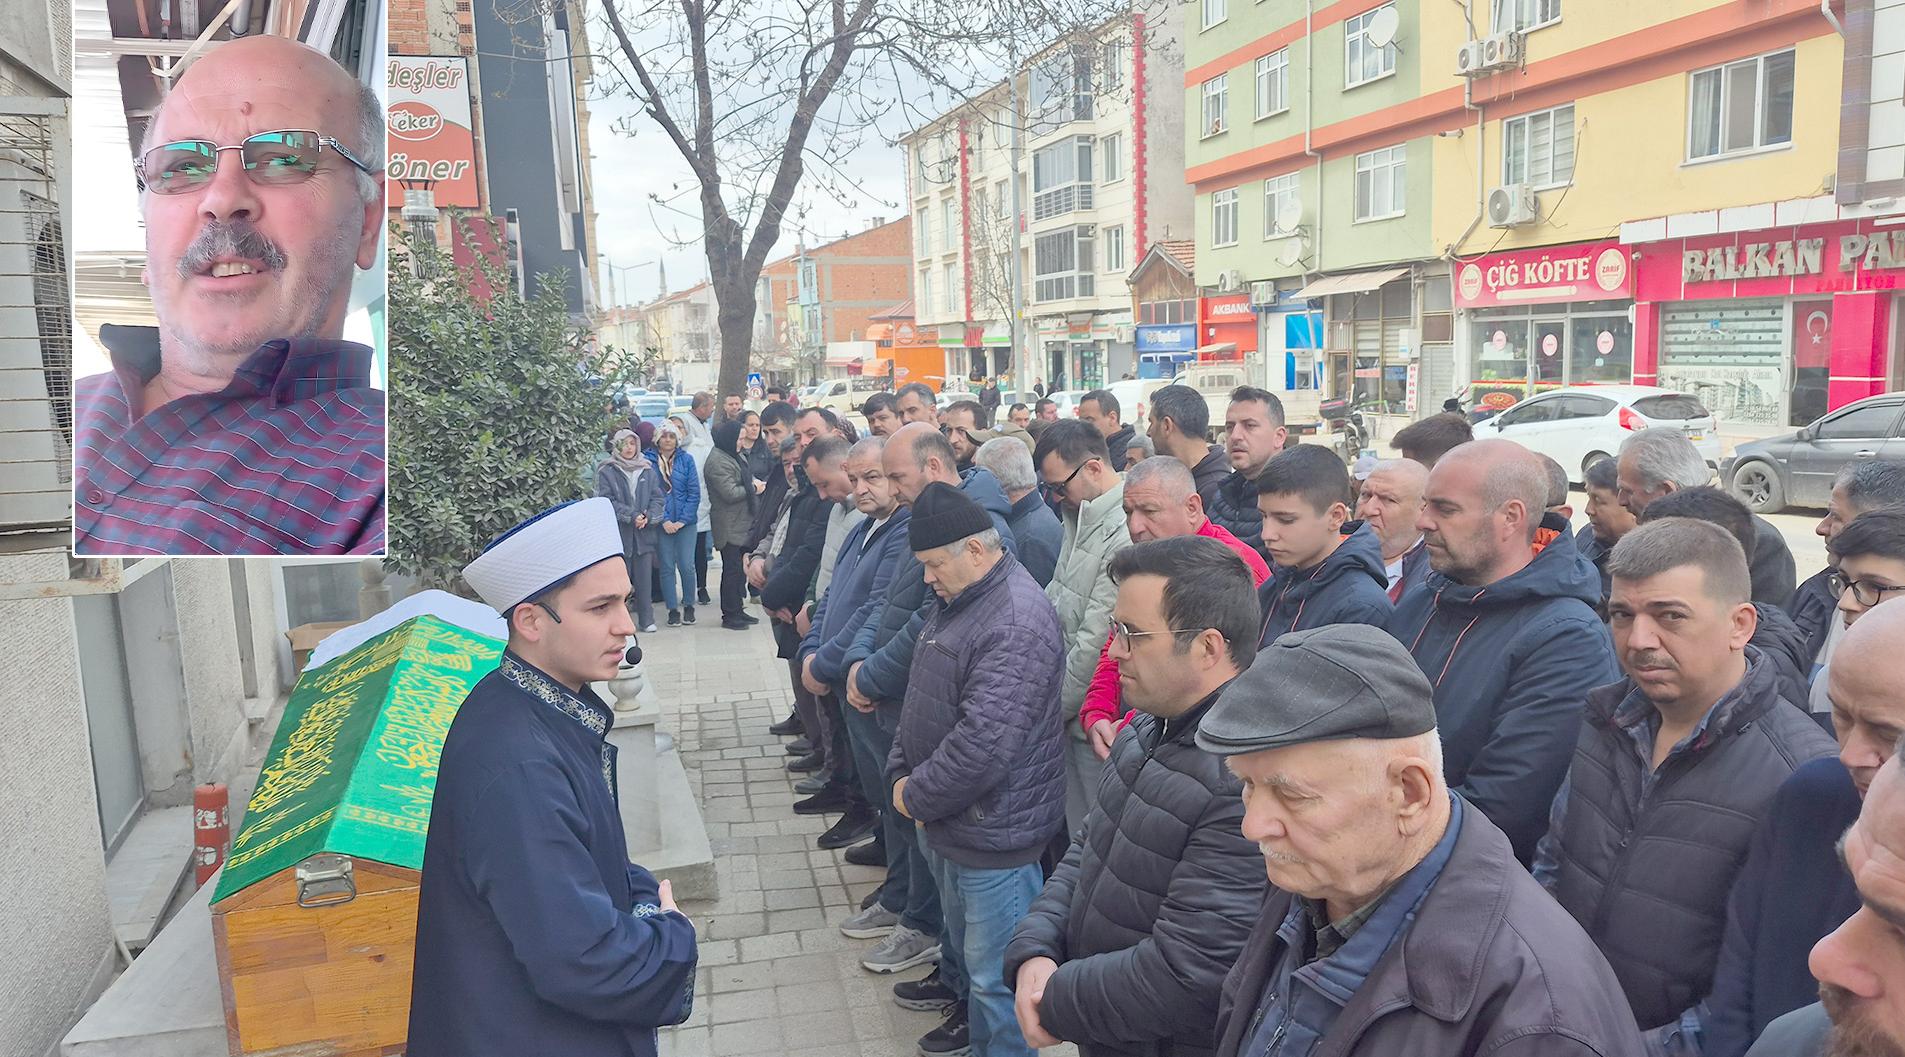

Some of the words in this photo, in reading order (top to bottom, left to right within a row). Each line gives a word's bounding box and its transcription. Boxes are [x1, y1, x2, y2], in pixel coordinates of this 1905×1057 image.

[1486, 258, 1519, 292] ÇİĞ
[1524, 255, 1590, 285] KÖFTE
[1683, 237, 1824, 283] BALKAN
[1212, 302, 1250, 316] AKBANK
